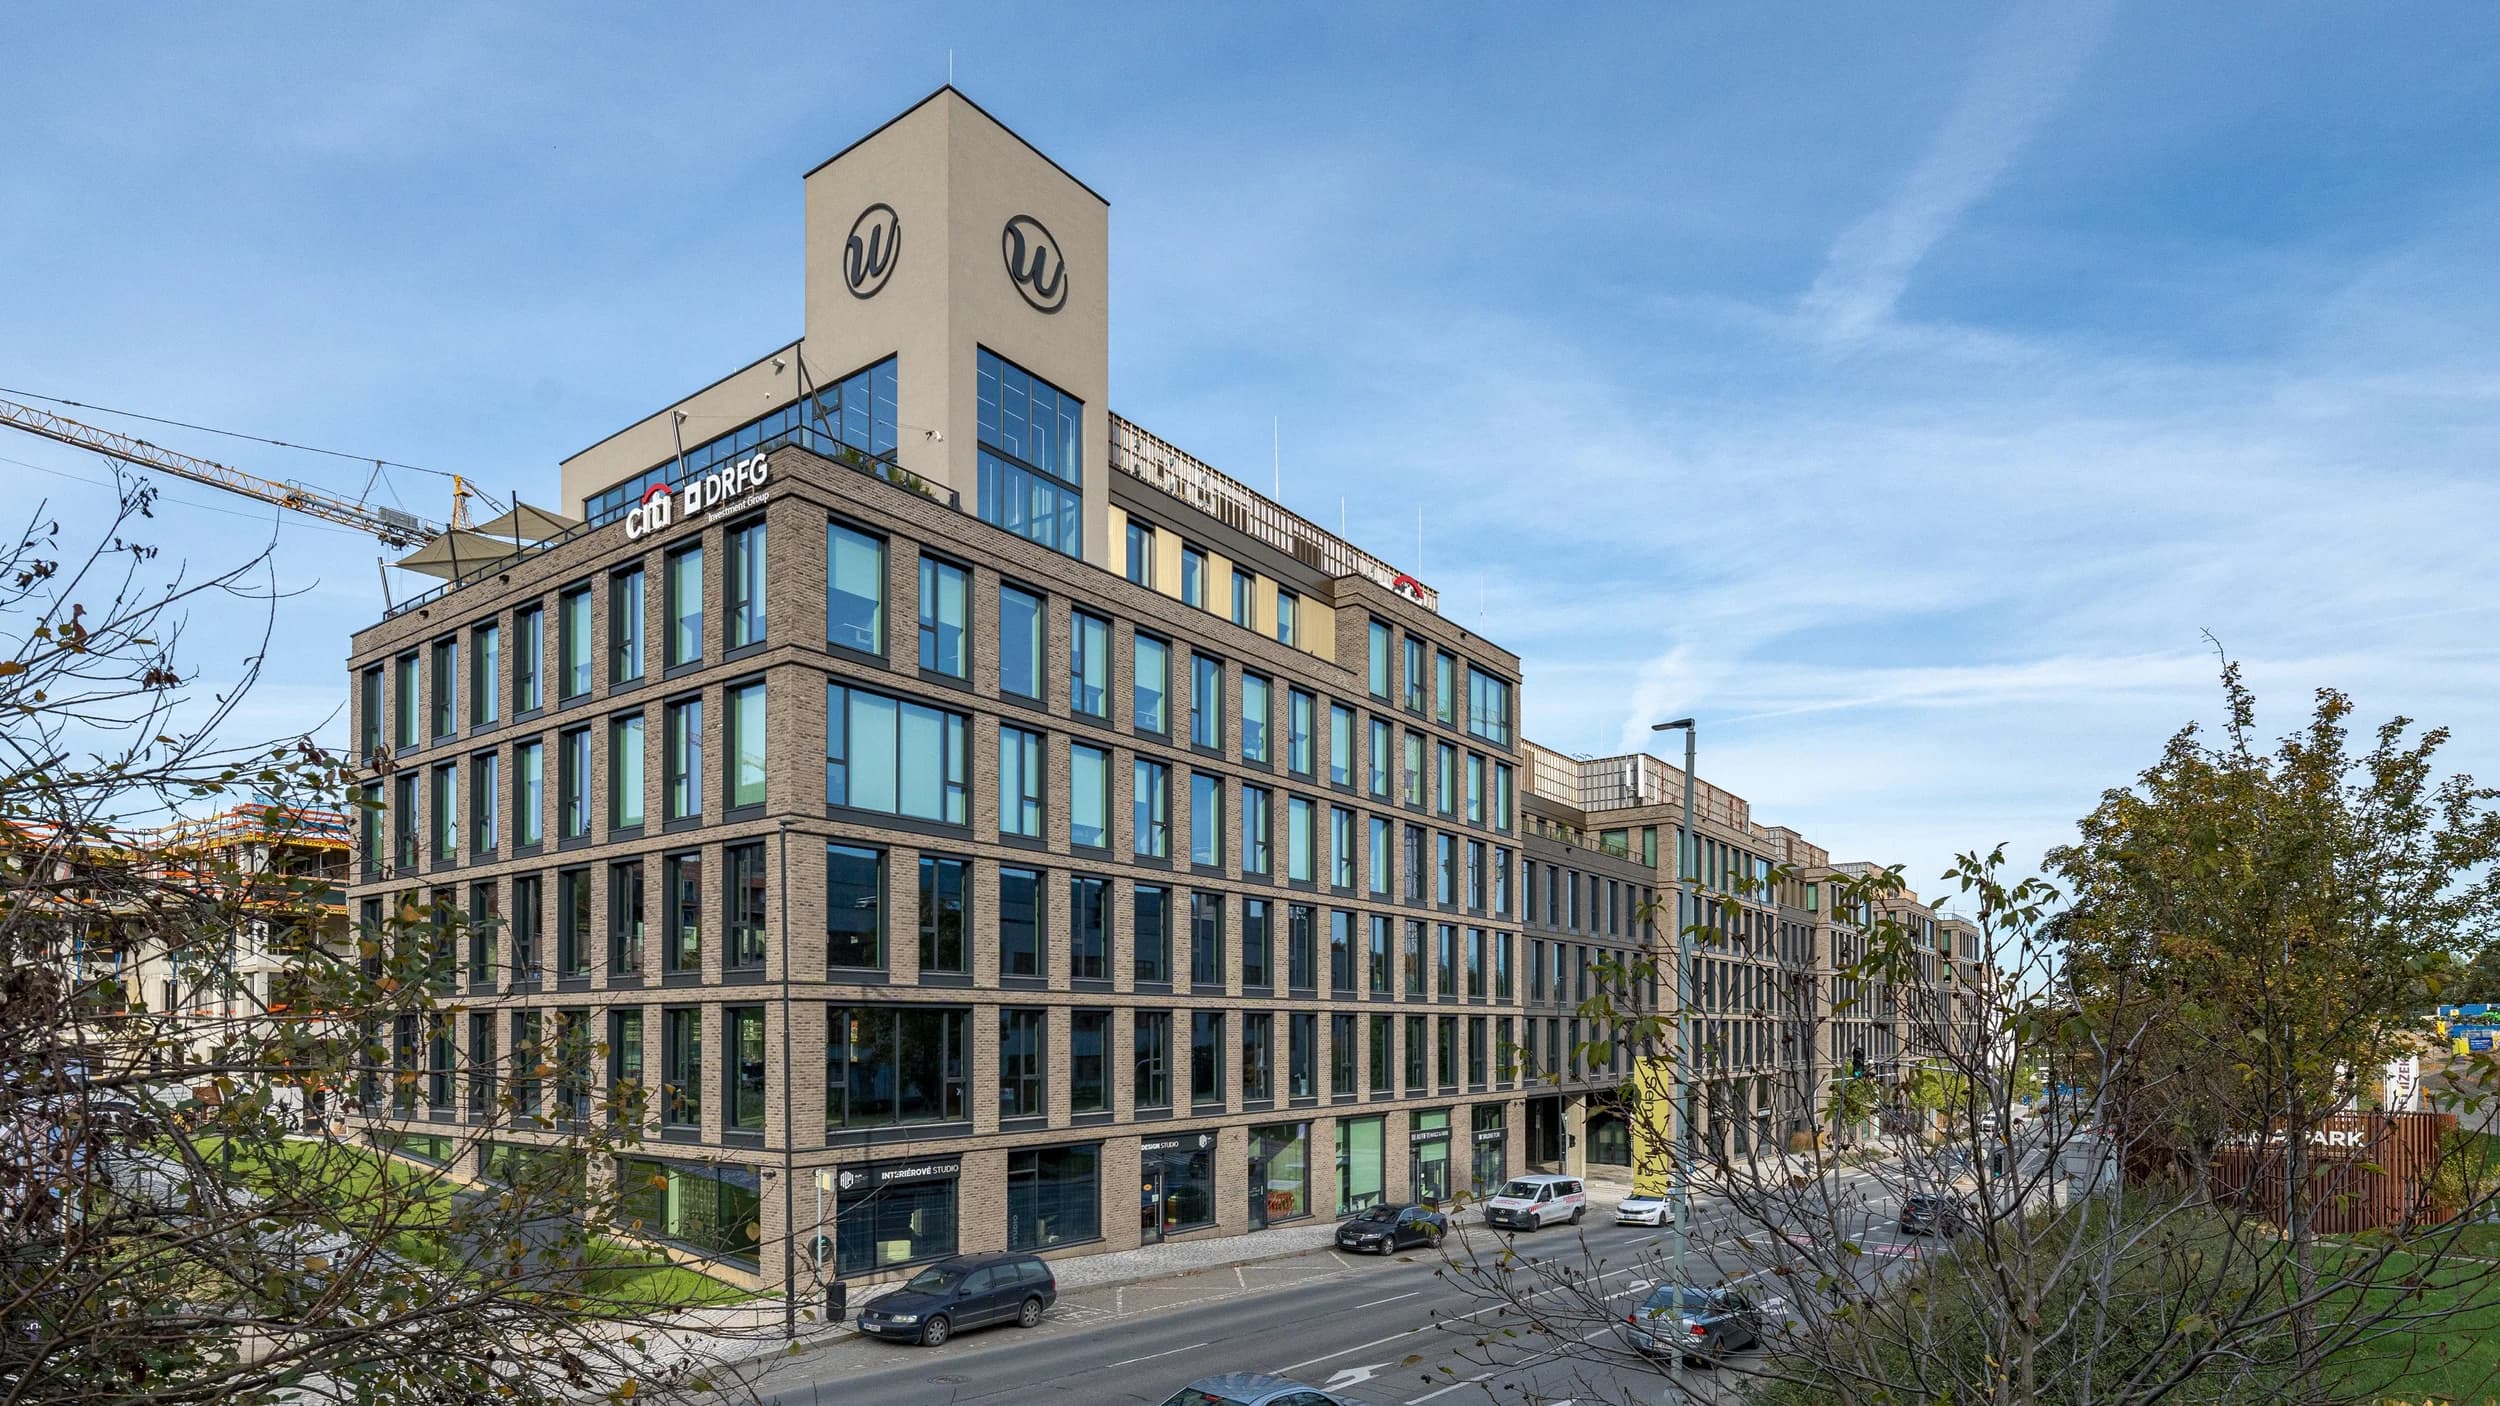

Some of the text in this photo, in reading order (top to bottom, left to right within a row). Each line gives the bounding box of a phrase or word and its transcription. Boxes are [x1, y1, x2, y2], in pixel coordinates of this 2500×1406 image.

[704, 453, 768, 507] DRFG
[626, 485, 672, 539] citi
[708, 492, 769, 522] Investment Group
[1160, 1140, 1179, 1149] STUDIO
[881, 1165, 931, 1180] INTERIÉROVÉ
[932, 1164, 959, 1175] STUDIO
